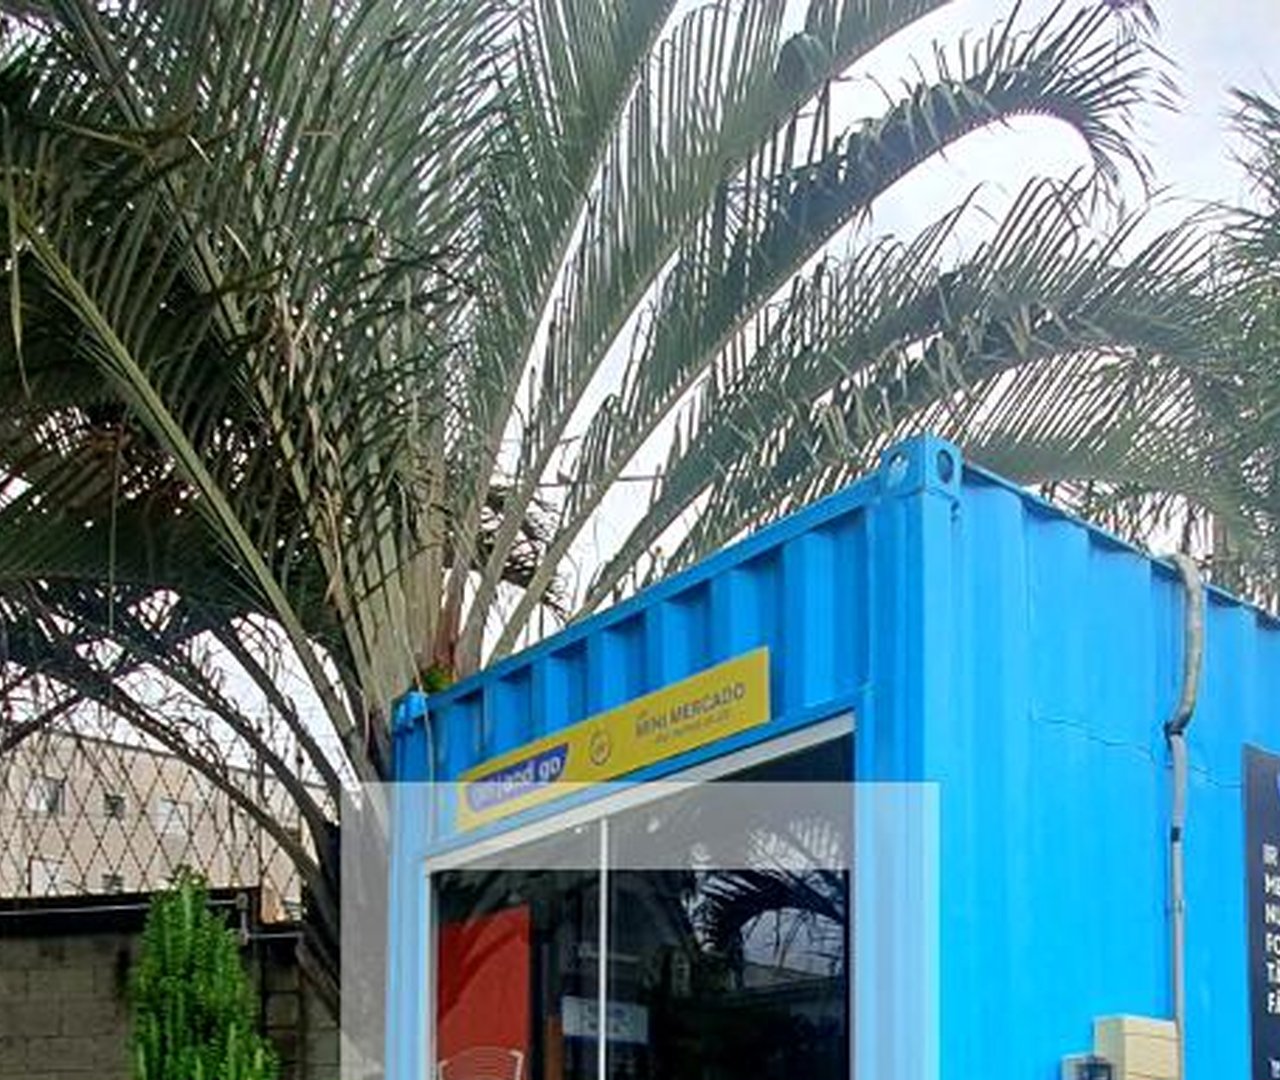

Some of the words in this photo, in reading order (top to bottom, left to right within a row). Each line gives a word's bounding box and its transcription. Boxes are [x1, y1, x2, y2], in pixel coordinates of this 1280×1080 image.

[671, 682, 746, 724] MERCADO
[538, 756, 561, 786] go
[1262, 843, 1278, 867] IR
